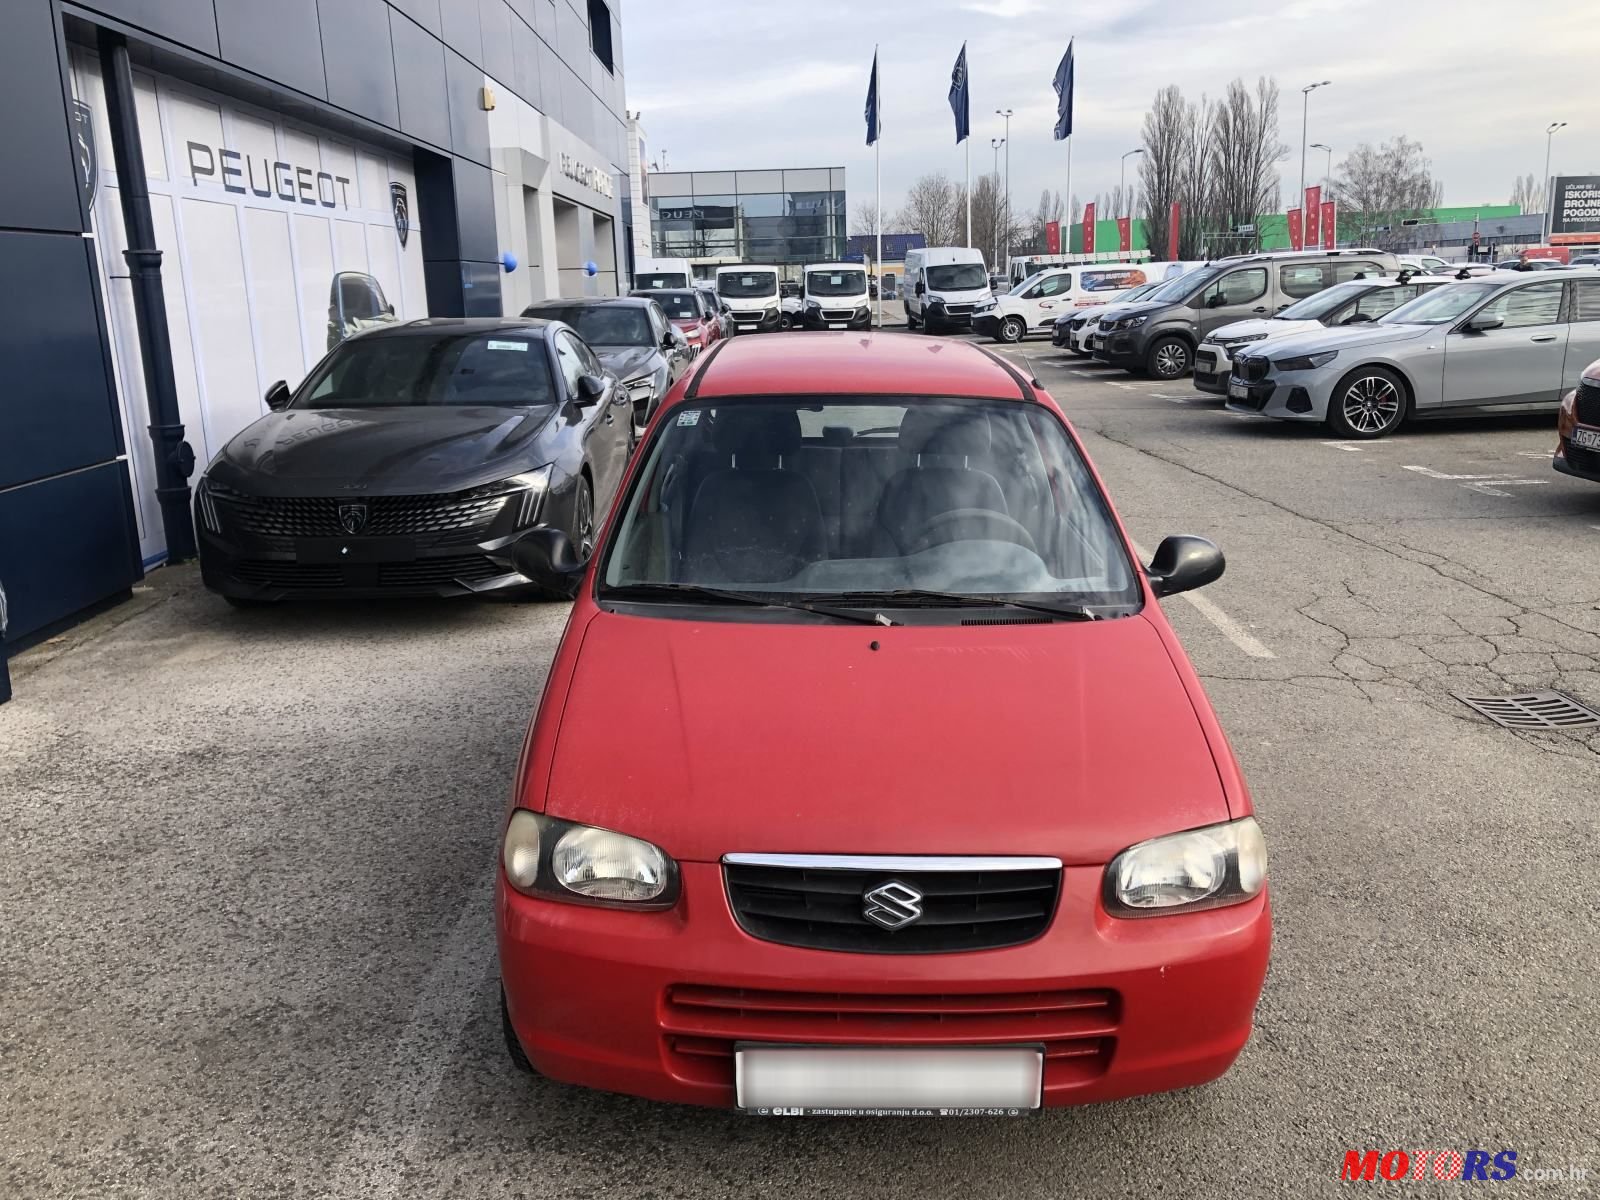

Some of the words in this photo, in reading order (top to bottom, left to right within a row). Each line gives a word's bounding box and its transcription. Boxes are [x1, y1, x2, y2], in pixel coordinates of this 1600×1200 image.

[187, 141, 350, 211] PEUGEOT
[1577, 431, 1587, 443] ZG
[811, 1108, 856, 1117] zastupanje
[865, 1108, 910, 1117] osiguranju
[911, 1108, 934, 1116] d.o.o.
